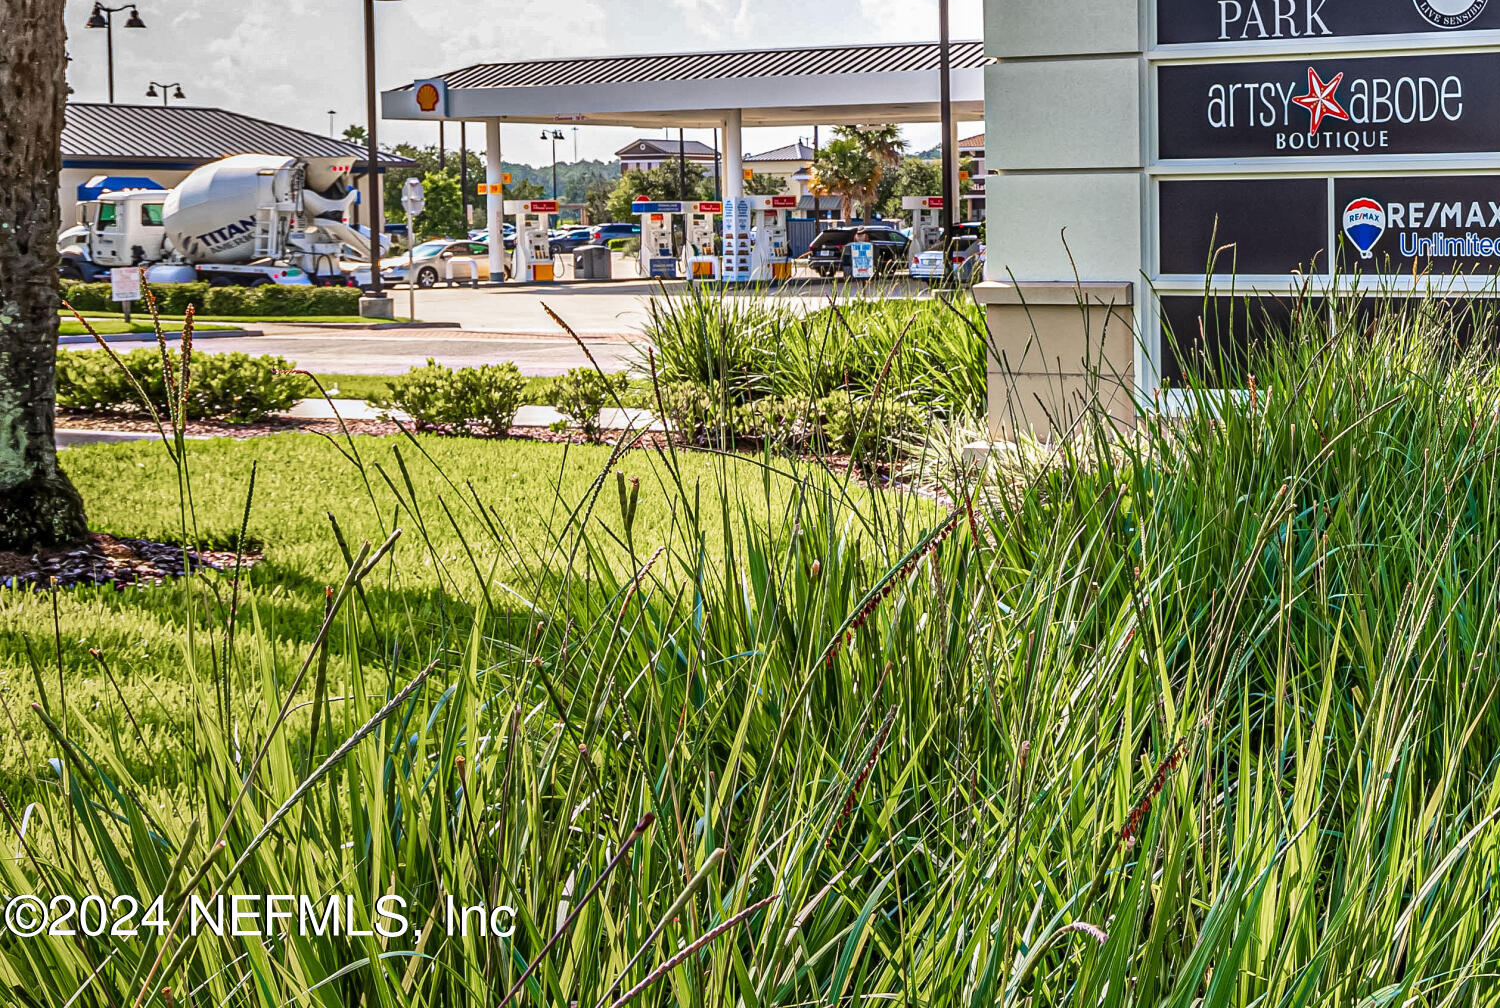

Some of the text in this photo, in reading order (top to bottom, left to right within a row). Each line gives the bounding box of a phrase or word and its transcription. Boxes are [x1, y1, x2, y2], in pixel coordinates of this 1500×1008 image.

[1420, 2, 1442, 22] LIVE
[1276, 130, 1389, 152] BOUTIQUE
[1349, 212, 1380, 223] RE/MAX
[196, 214, 257, 247] TITAN
